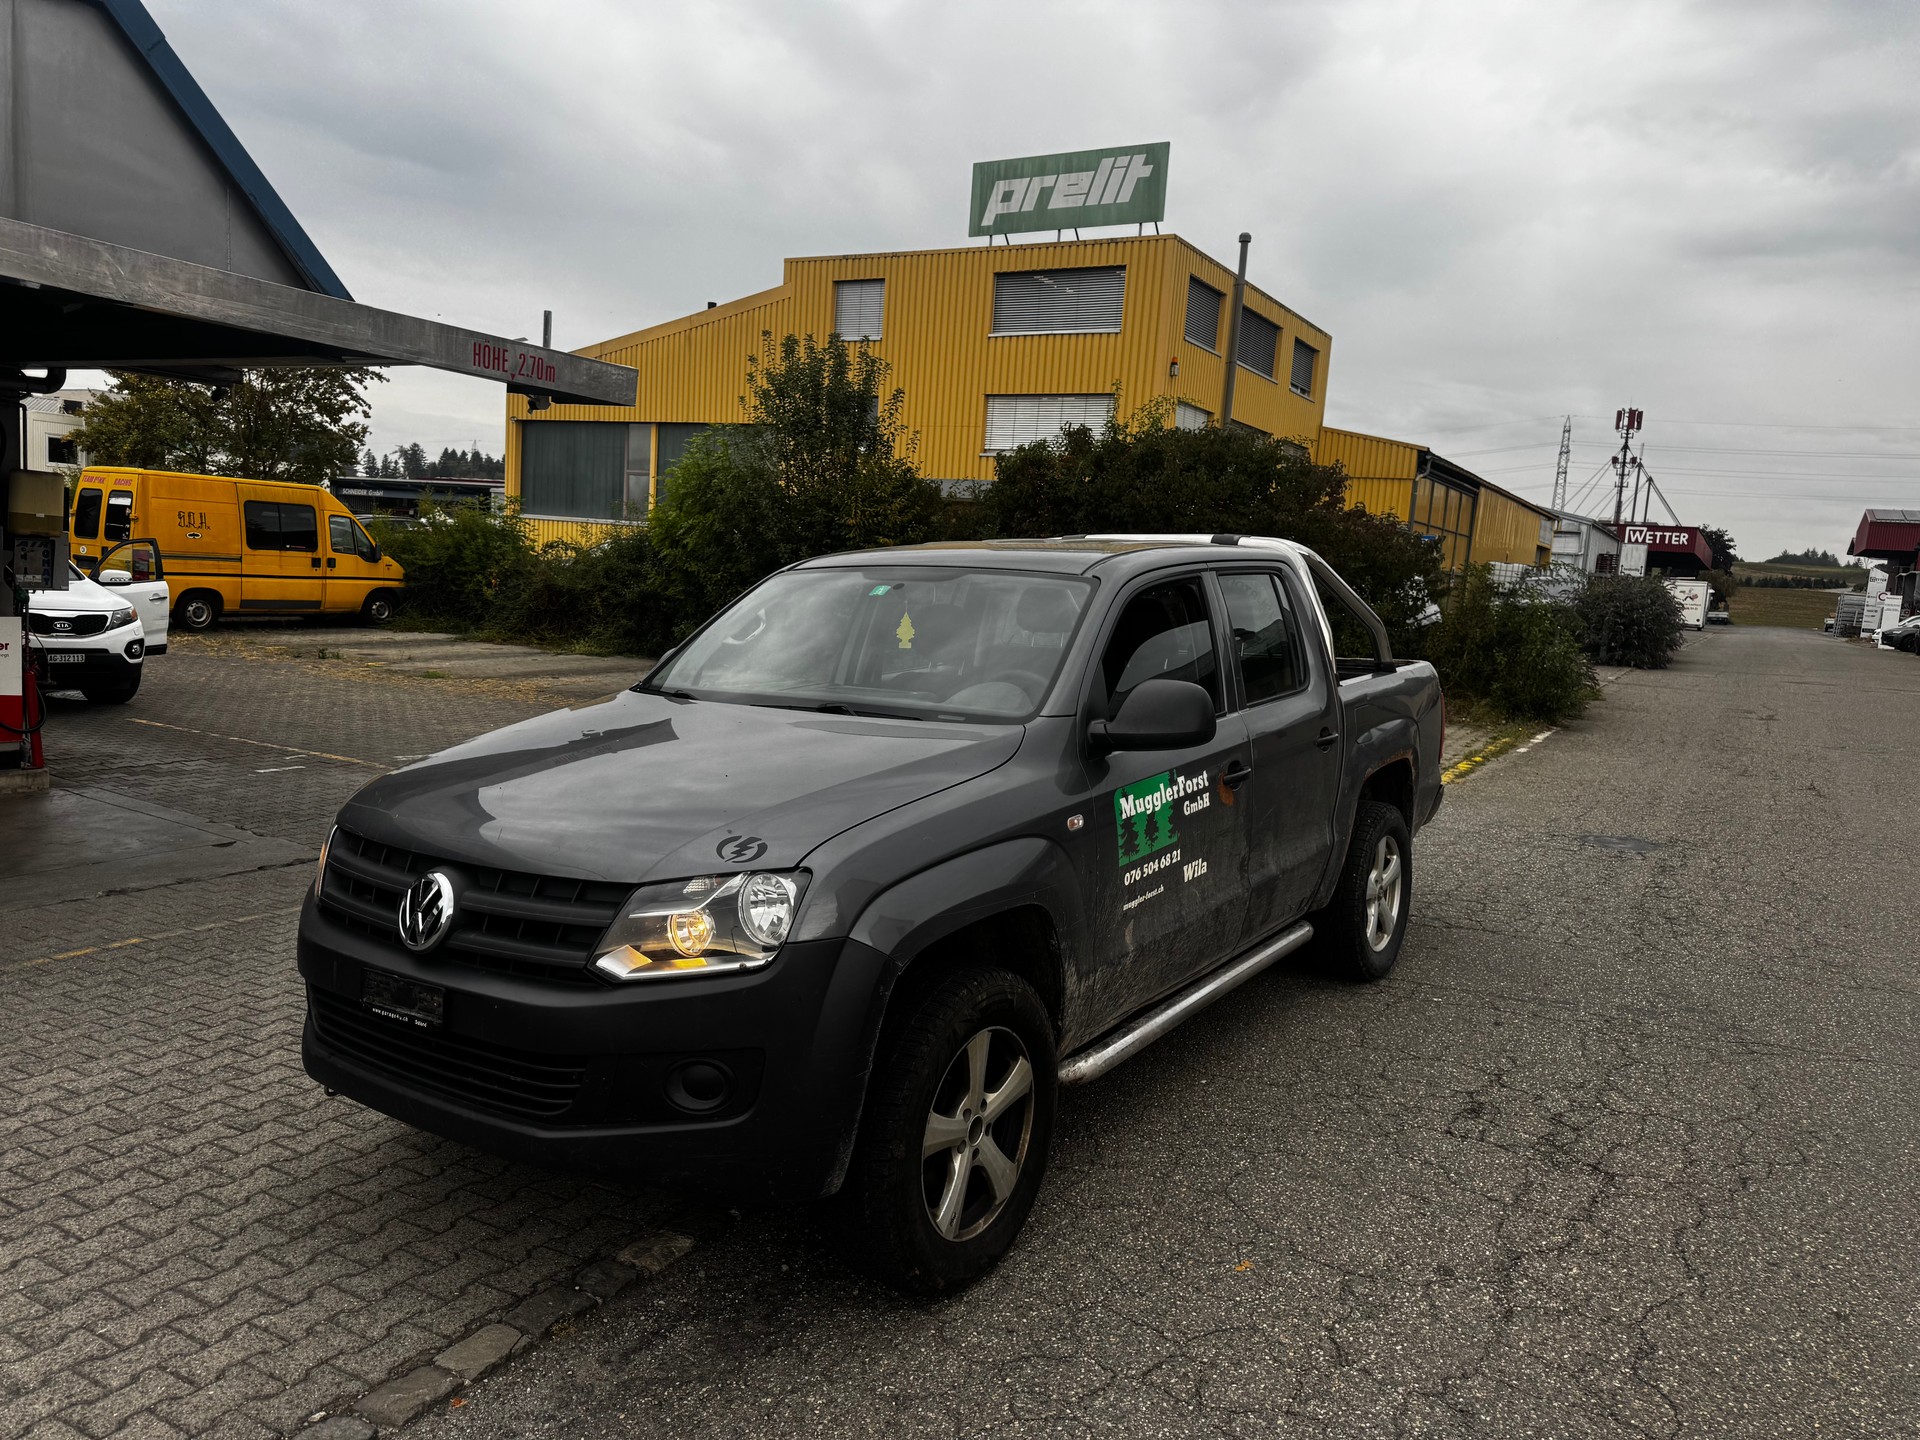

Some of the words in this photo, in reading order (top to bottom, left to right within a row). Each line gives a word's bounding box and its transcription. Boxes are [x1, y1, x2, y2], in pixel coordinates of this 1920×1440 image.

[980, 153, 1154, 227] prelit
[473, 339, 508, 373] HÖHE
[1625, 526, 1689, 545] WETTER
[1183, 792, 1211, 816] GmbH
[1124, 869, 1142, 886] 076
[1143, 861, 1159, 877] 504
[1160, 855, 1171, 871] 68
[1171, 849, 1181, 863] 21
[1183, 858, 1208, 883] Wila
